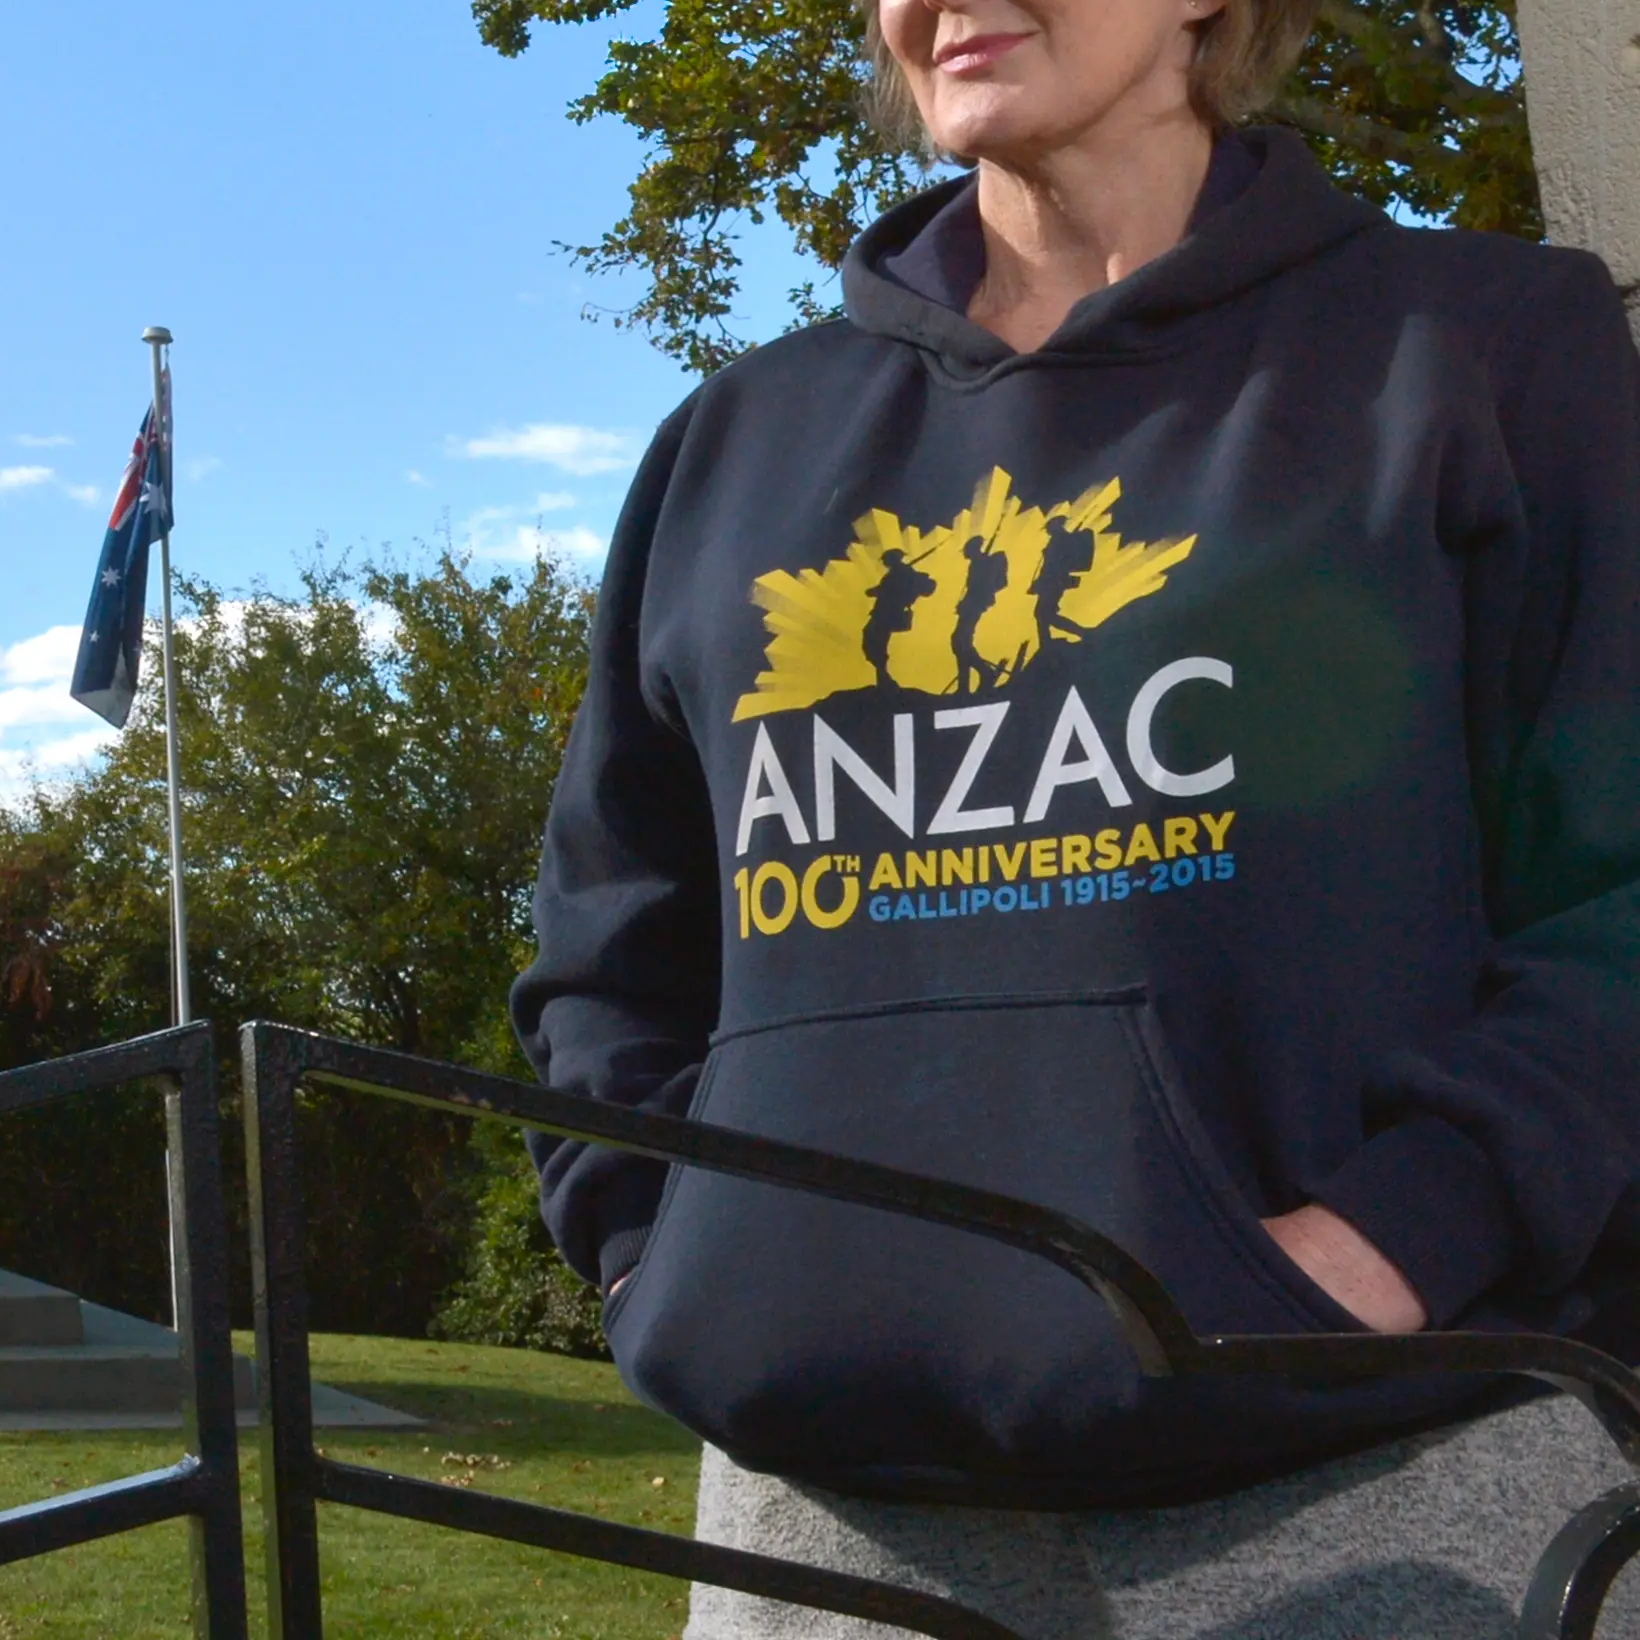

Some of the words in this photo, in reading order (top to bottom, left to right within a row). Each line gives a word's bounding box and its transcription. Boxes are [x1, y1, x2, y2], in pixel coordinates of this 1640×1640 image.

[735, 657, 1235, 856] ANZAC
[869, 811, 1235, 890] ANNIVERSARY
[868, 883, 1050, 922] GALLIPOLI
